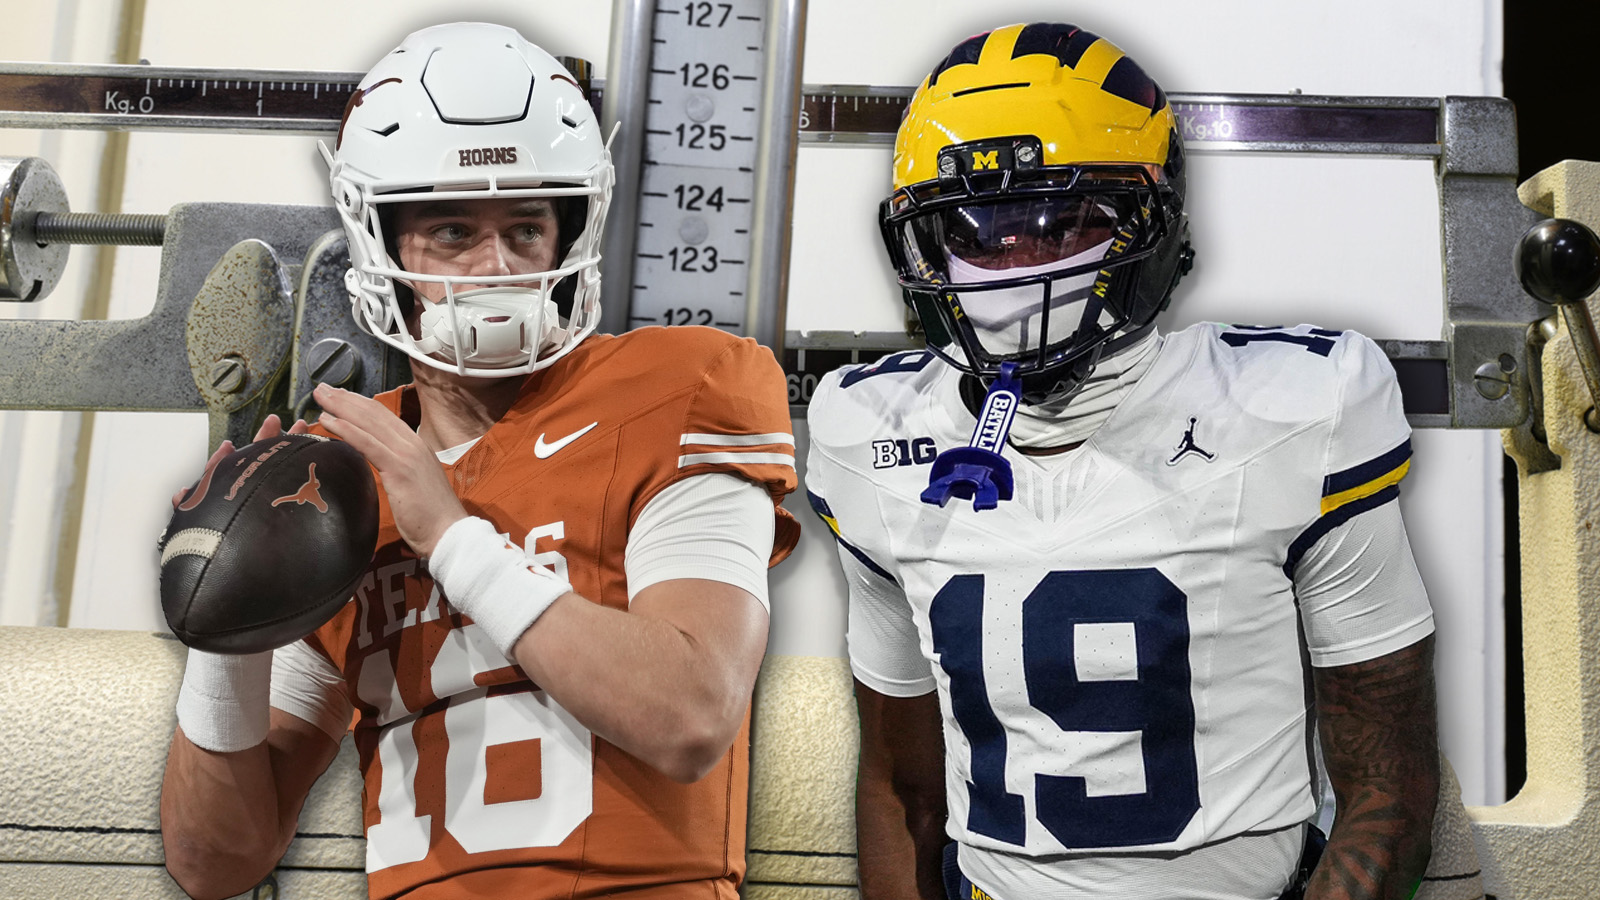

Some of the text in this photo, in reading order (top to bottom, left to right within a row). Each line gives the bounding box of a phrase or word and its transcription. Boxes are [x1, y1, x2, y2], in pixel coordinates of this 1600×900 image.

[685, 1, 733, 28] 127
[680, 62, 729, 90] 126
[256, 99, 263, 116] 1
[676, 123, 726, 151] 125
[458, 147, 518, 167] HORNS
[972, 150, 999, 170] M
[674, 184, 724, 212] 124
[669, 246, 718, 273] 123
[663, 307, 713, 327] 122
[787, 374, 818, 402] 60
[929, 567, 1202, 850] 19
[365, 623, 593, 874] 16
